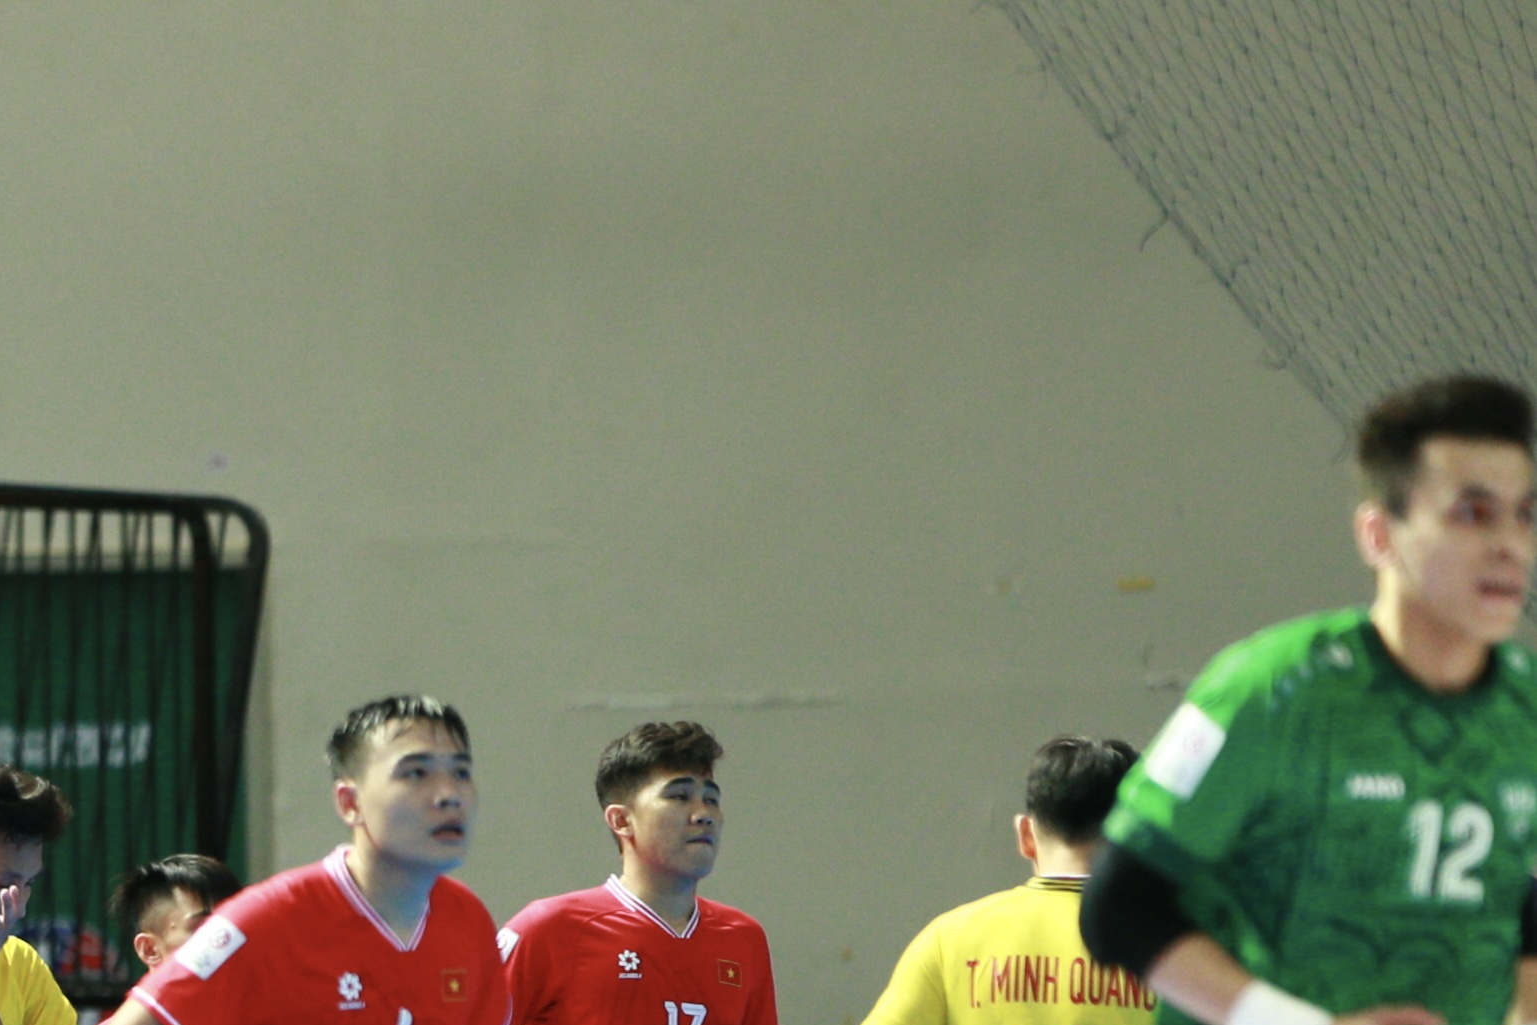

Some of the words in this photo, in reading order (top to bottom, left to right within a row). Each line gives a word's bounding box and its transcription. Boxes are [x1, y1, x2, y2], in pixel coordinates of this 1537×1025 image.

[1406, 798, 1494, 903] 12
[966, 960, 981, 1009] T.
[990, 955, 1060, 1004] MINH
